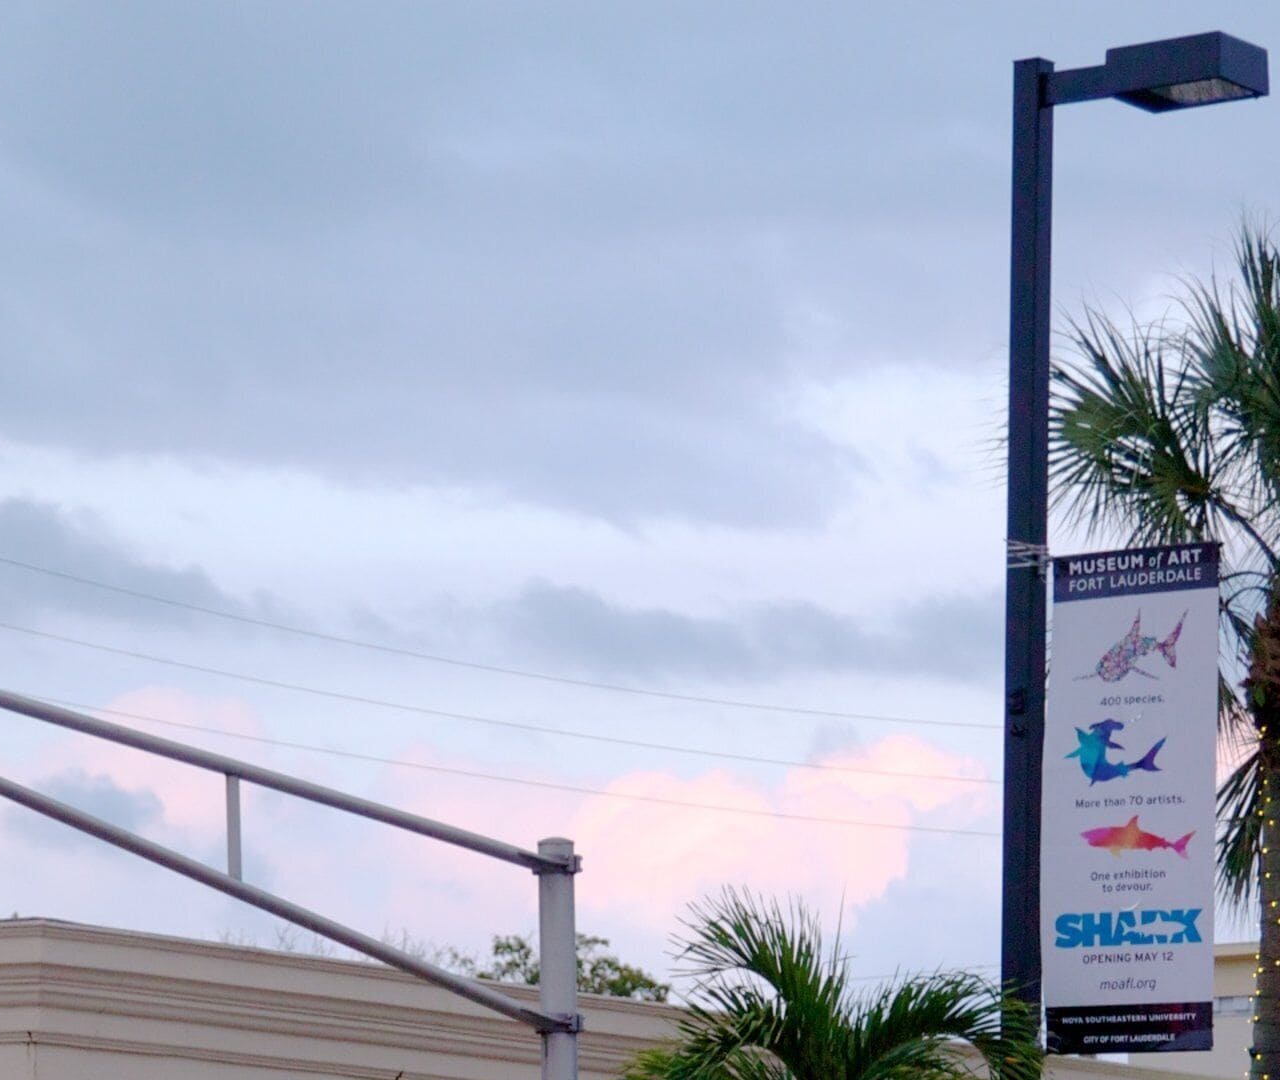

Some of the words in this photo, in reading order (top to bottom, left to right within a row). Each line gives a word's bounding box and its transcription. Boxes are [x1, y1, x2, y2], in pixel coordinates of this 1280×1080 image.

[1069, 554, 1144, 577] MUSEUM
[1149, 552, 1164, 568] of
[1168, 549, 1202, 565] ART
[1069, 577, 1105, 592] FORT
[1110, 568, 1202, 589] LAUDERDALE
[1100, 696, 1122, 707] 400
[1124, 694, 1165, 707] species.
[1075, 799, 1101, 809] More
[1104, 797, 1126, 808] than
[1129, 795, 1144, 806] 70
[1146, 794, 1185, 805] artists.
[1090, 871, 1111, 881] One
[1114, 869, 1167, 880] exhibition
[1102, 883, 1113, 893] to
[1115, 882, 1153, 892] devour.
[1082, 953, 1132, 965] OPENING
[1135, 952, 1158, 963] MAY
[1162, 951, 1174, 961] 12
[1099, 977, 1157, 991] moafl.org
[1062, 1016, 1084, 1025] NOVA
[1085, 1014, 1147, 1024] SOUTHEASTERN
[1149, 1012, 1197, 1022] UNIVERSITY
[1083, 1035, 1098, 1044] CITY
[1099, 1035, 1110, 1043] OF
[1111, 1034, 1128, 1043] FORT
[1130, 1033, 1176, 1042] LAUDERDALE
